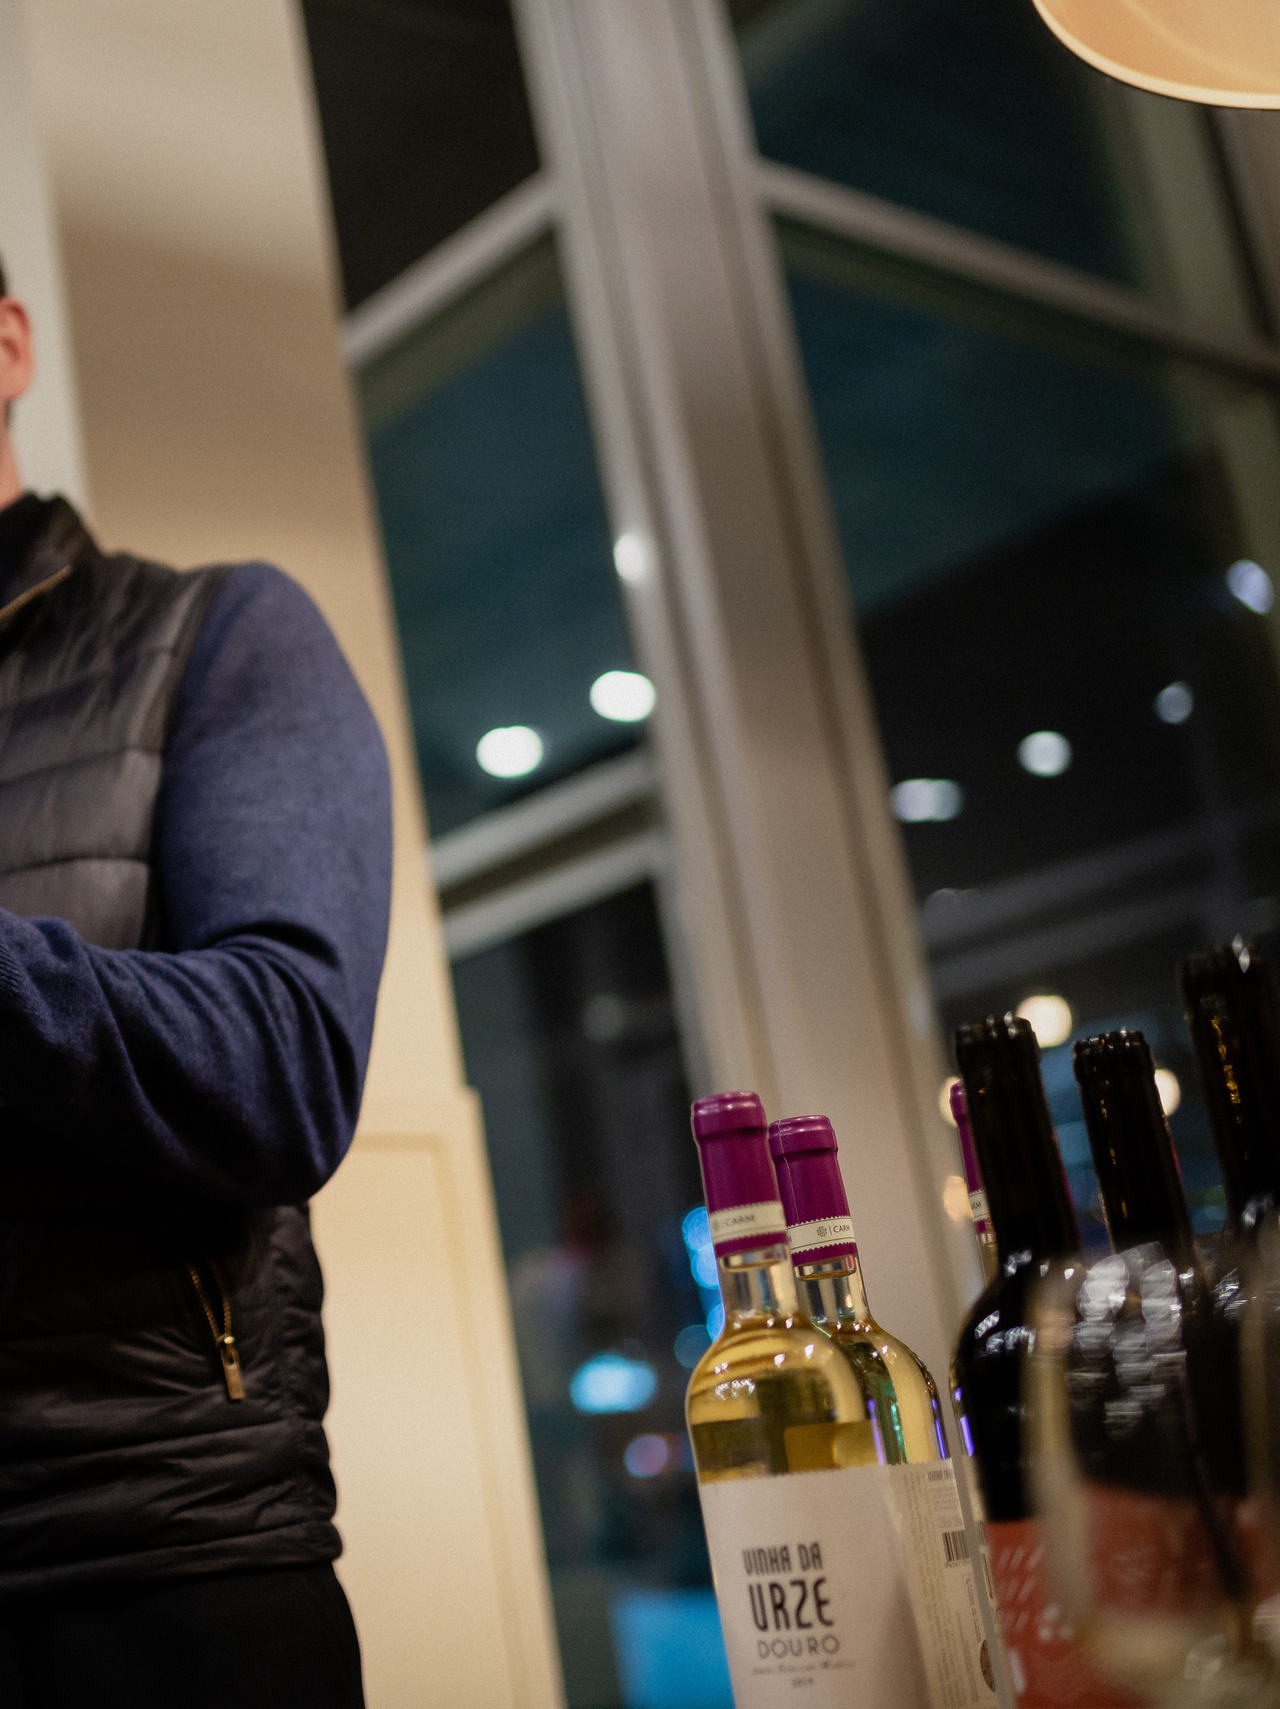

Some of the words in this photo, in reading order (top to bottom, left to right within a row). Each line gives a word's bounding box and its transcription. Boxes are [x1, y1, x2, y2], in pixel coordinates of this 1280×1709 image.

[742, 1545, 792, 1576] VINHA
[797, 1542, 823, 1572] DA
[748, 1576, 834, 1632] URZE
[757, 1634, 840, 1659] DOURO
